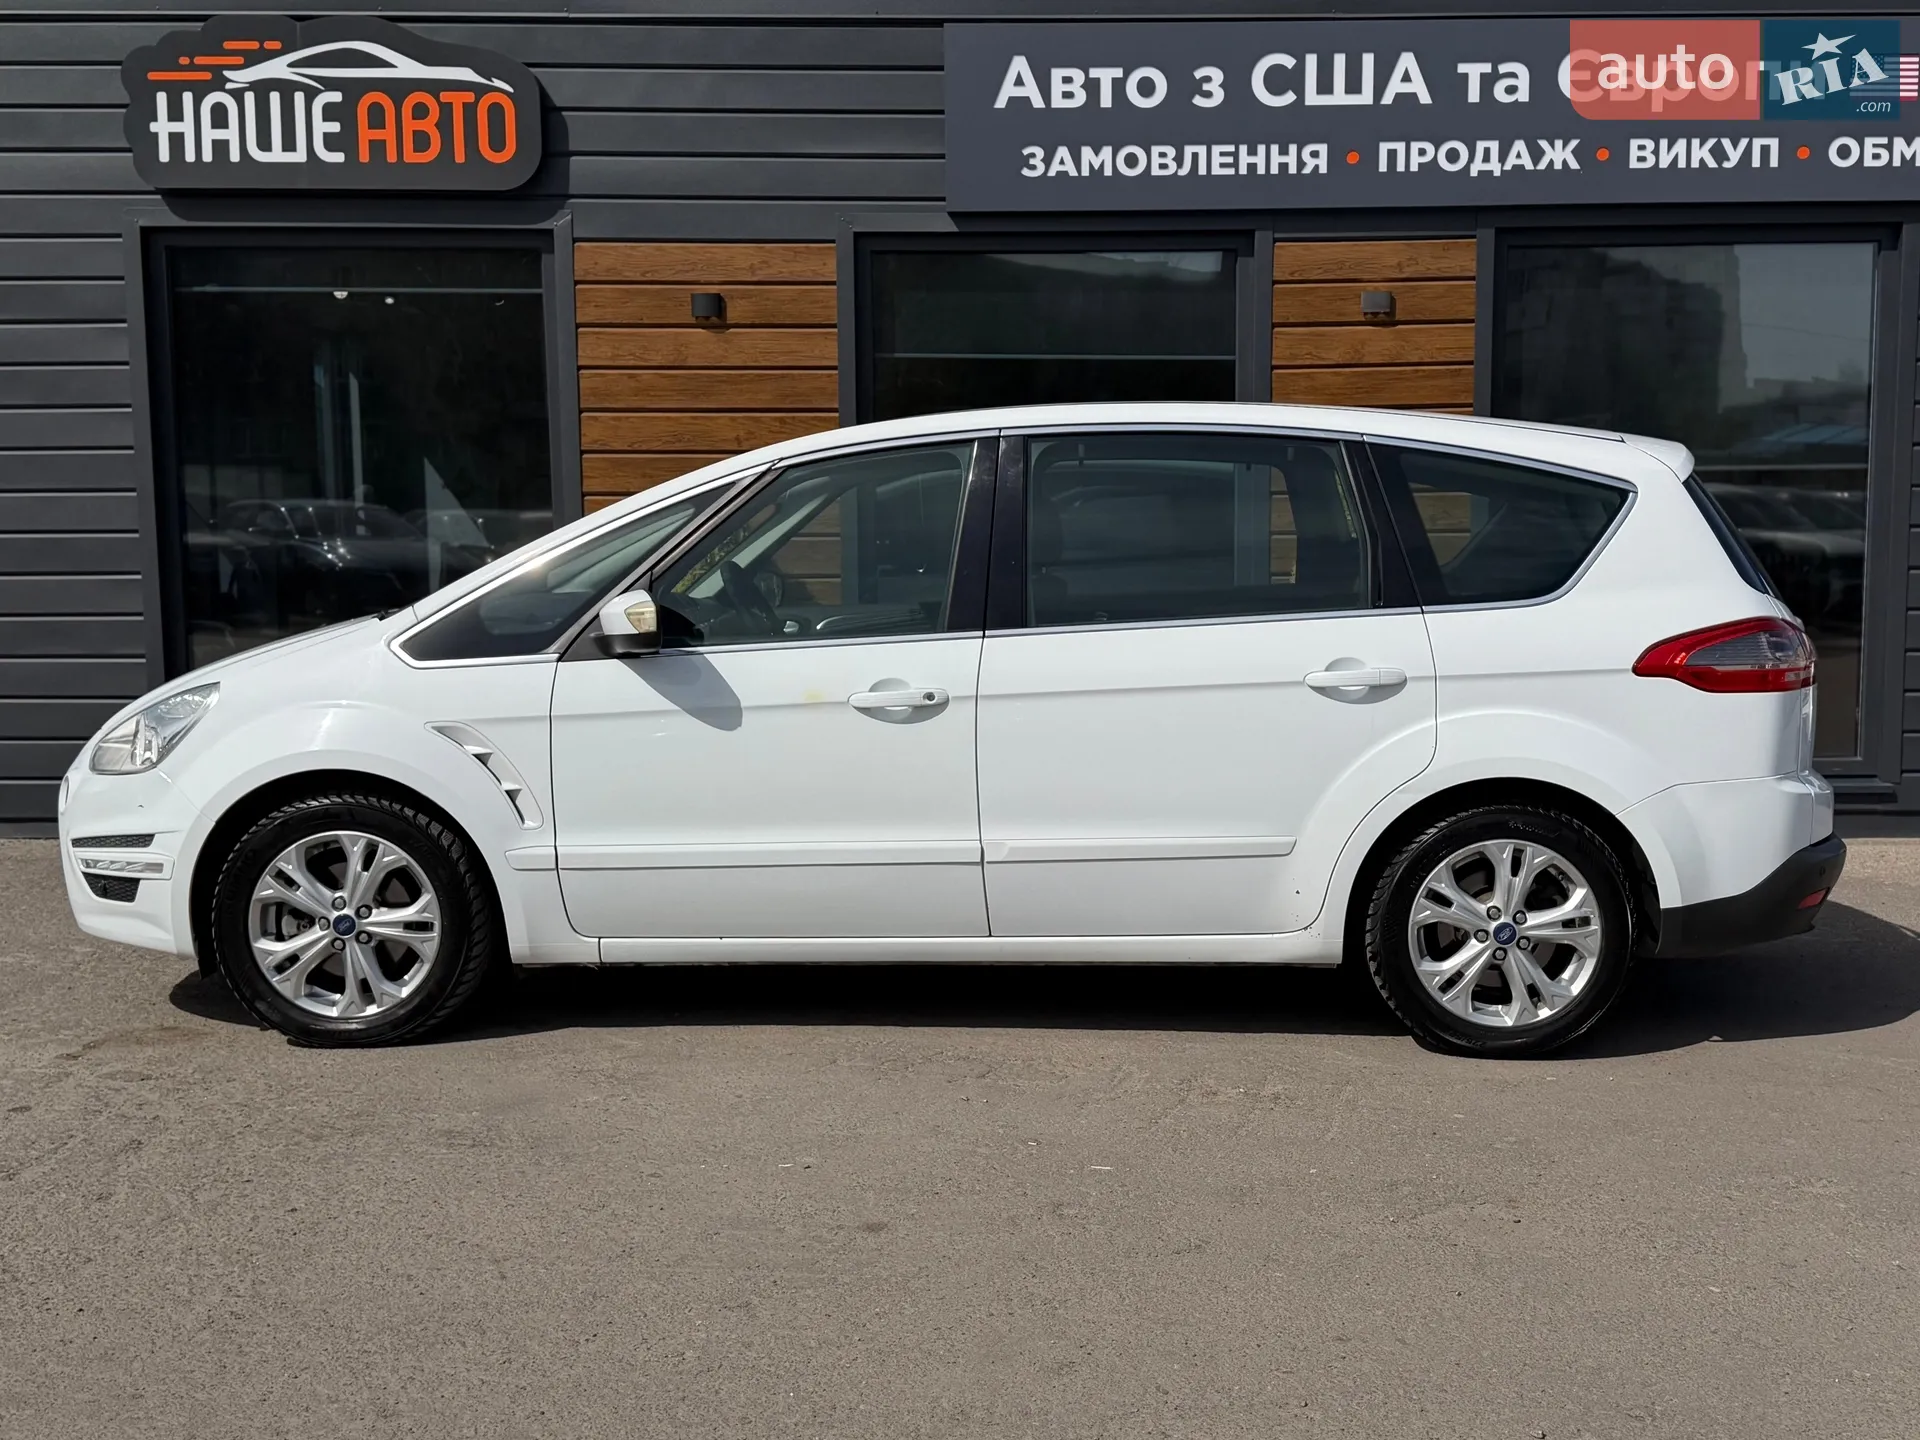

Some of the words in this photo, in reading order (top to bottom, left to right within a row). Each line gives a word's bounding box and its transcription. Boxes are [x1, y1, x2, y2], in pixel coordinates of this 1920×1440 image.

[993, 55, 1168, 109] Авто
[1191, 66, 1225, 108] з
[1251, 51, 1433, 107] США
[1456, 61, 1531, 104] та
[149, 91, 346, 163] НАШЕ
[356, 91, 518, 164] АВТО
[1020, 143, 1328, 178] ЗАМОВЛЕННЯ
[1378, 138, 1581, 177] ПРОДАЖ
[1628, 137, 1780, 169] ВИКУП
[1827, 136, 1920, 168] ОБМ
